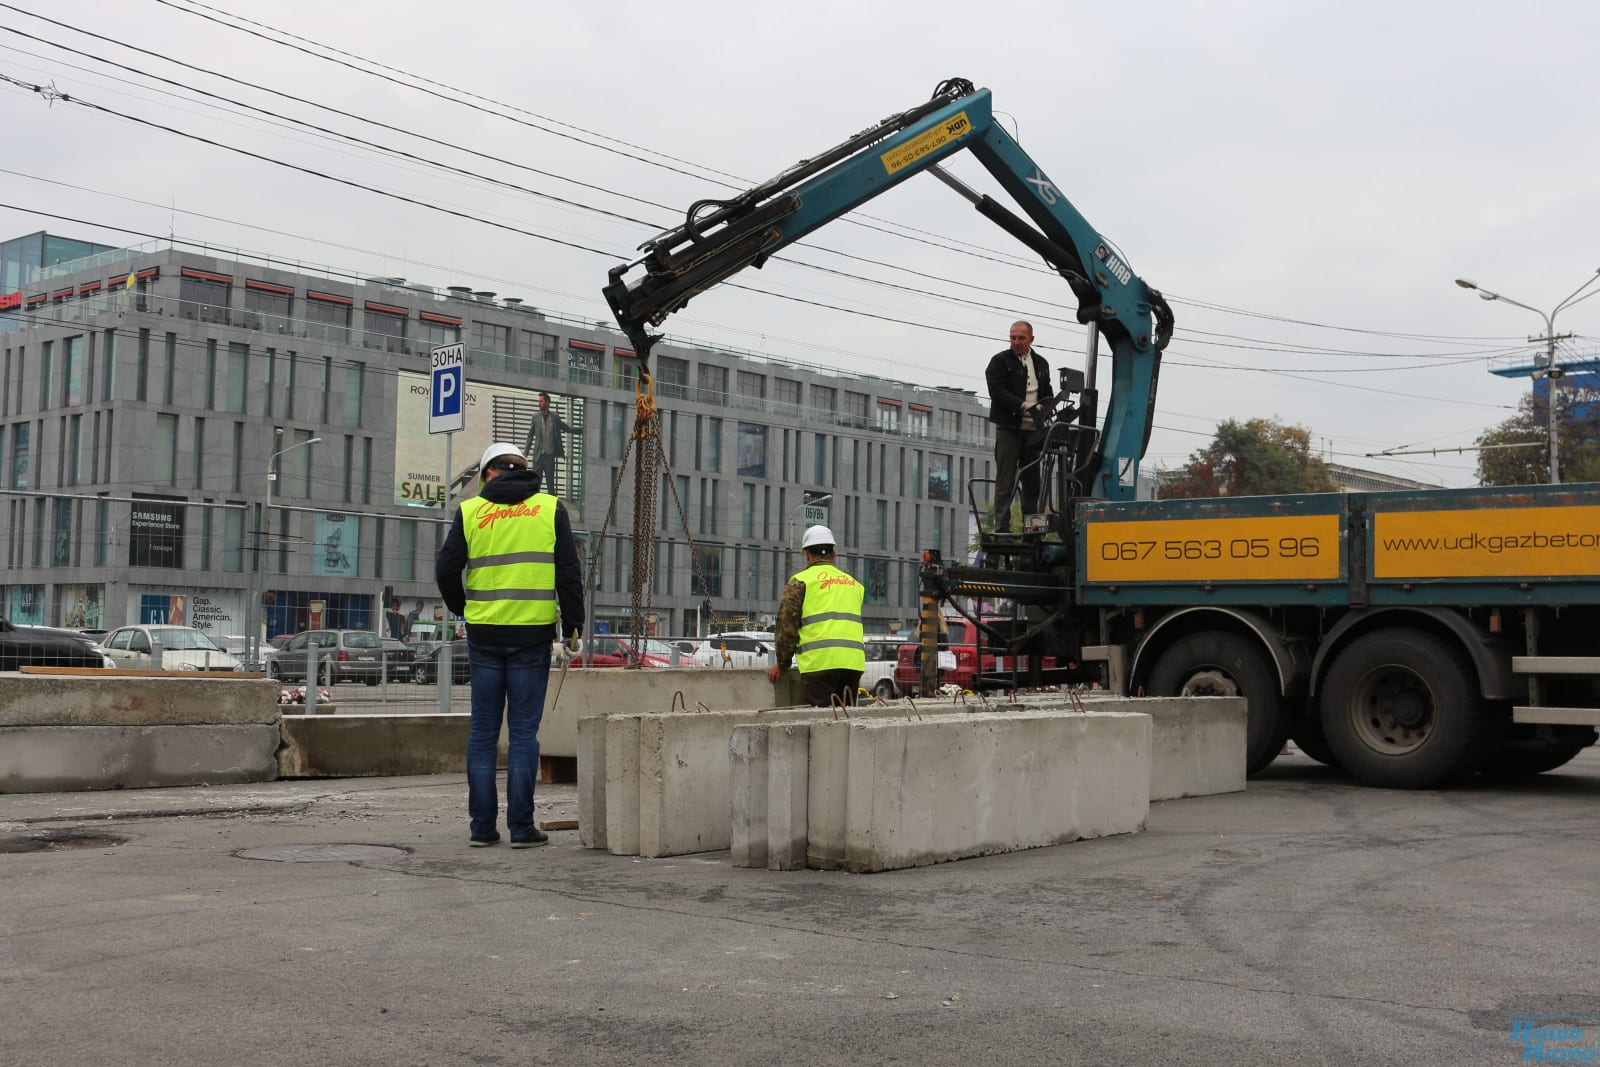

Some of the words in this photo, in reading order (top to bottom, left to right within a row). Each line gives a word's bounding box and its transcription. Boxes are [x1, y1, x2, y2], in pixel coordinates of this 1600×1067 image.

[946, 119, 967, 135] UDK
[432, 347, 463, 368] ЗОНА
[439, 372, 456, 413] P
[407, 472, 441, 483] SUMMER
[401, 481, 446, 503] SALE
[132, 511, 172, 522] SAMSUNG
[805, 507, 824, 520] ОБУВЬ
[132, 520, 164, 528] Experience
[165, 522, 180, 530] Store
[1101, 541, 1157, 561] 067
[1164, 540, 1222, 560] 563
[1230, 538, 1270, 559] 05
[1279, 537, 1320, 558] 96
[193, 597, 211, 606] Gap.
[193, 605, 223, 614] Classic.
[192, 613, 232, 621] American.
[192, 620, 214, 630] Style.
